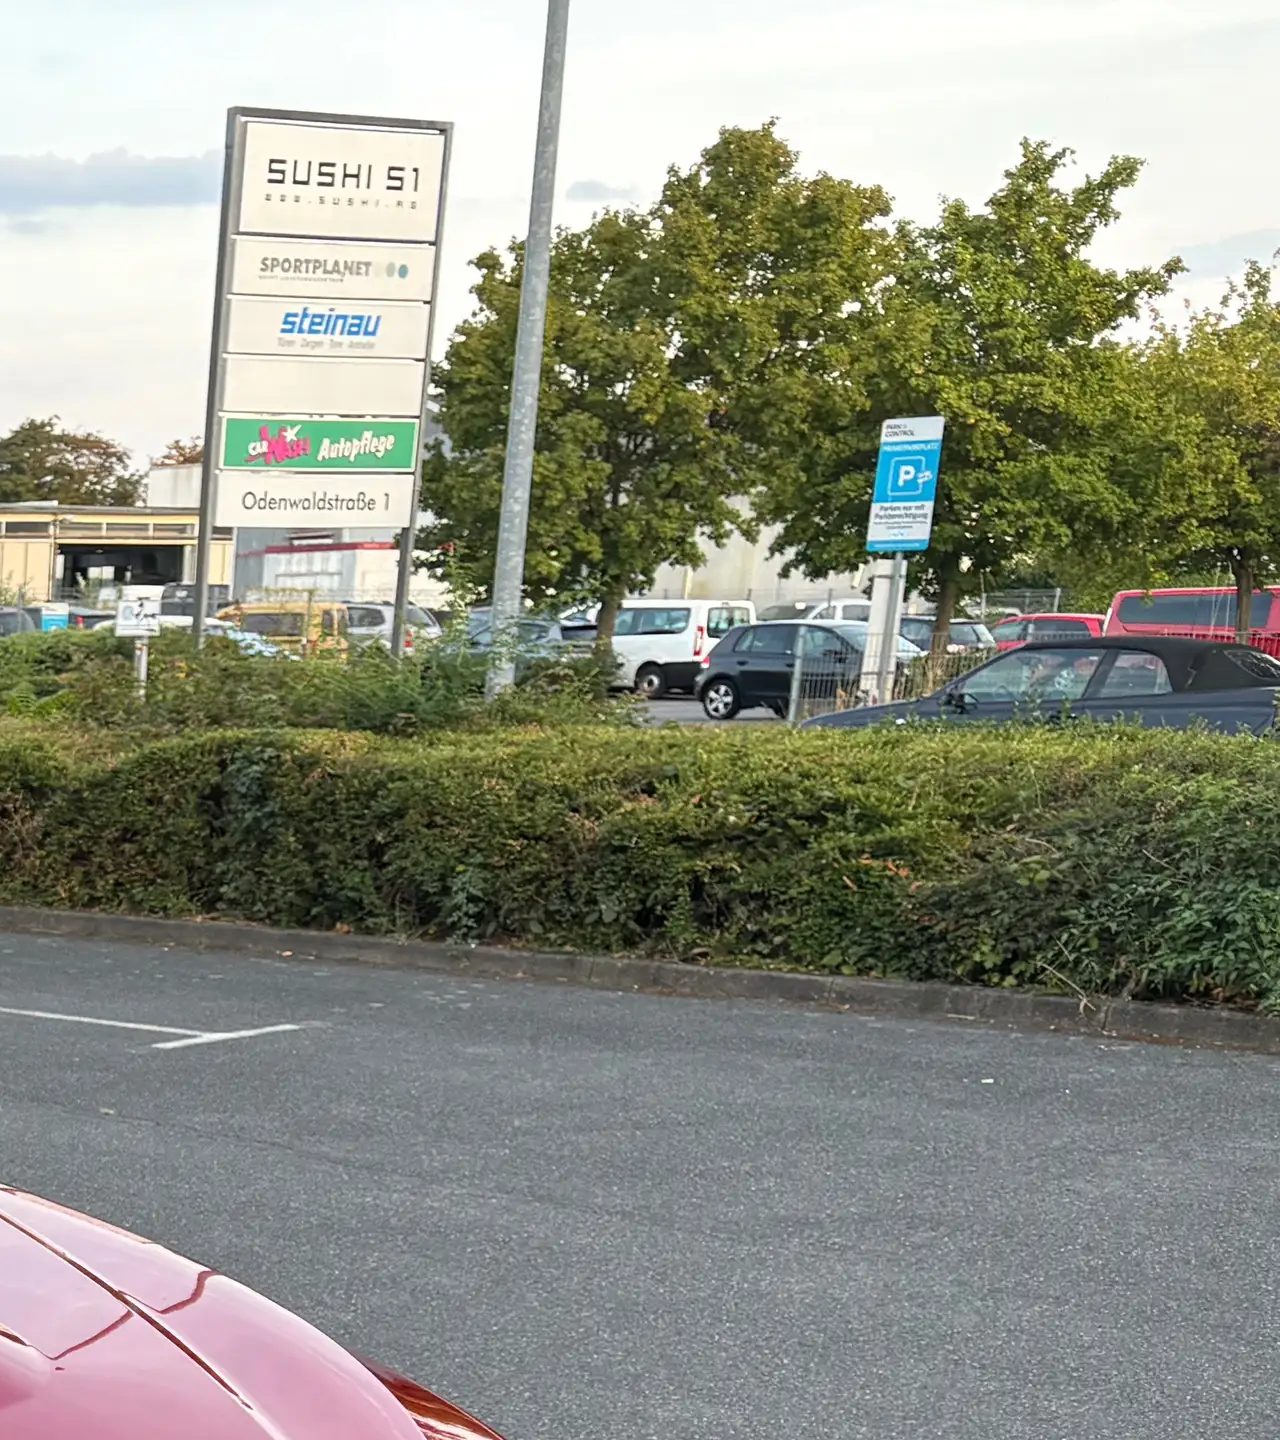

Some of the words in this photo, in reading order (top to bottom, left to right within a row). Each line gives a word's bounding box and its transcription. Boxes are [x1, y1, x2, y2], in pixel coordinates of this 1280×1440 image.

[266, 158, 372, 189] SUSHI
[260, 257, 372, 277] SPORTPLANET
[279, 306, 382, 336] steinau
[317, 430, 396, 462] Autopflege
[242, 490, 377, 511] Odenwaldstraße
[383, 492, 390, 510] 1
